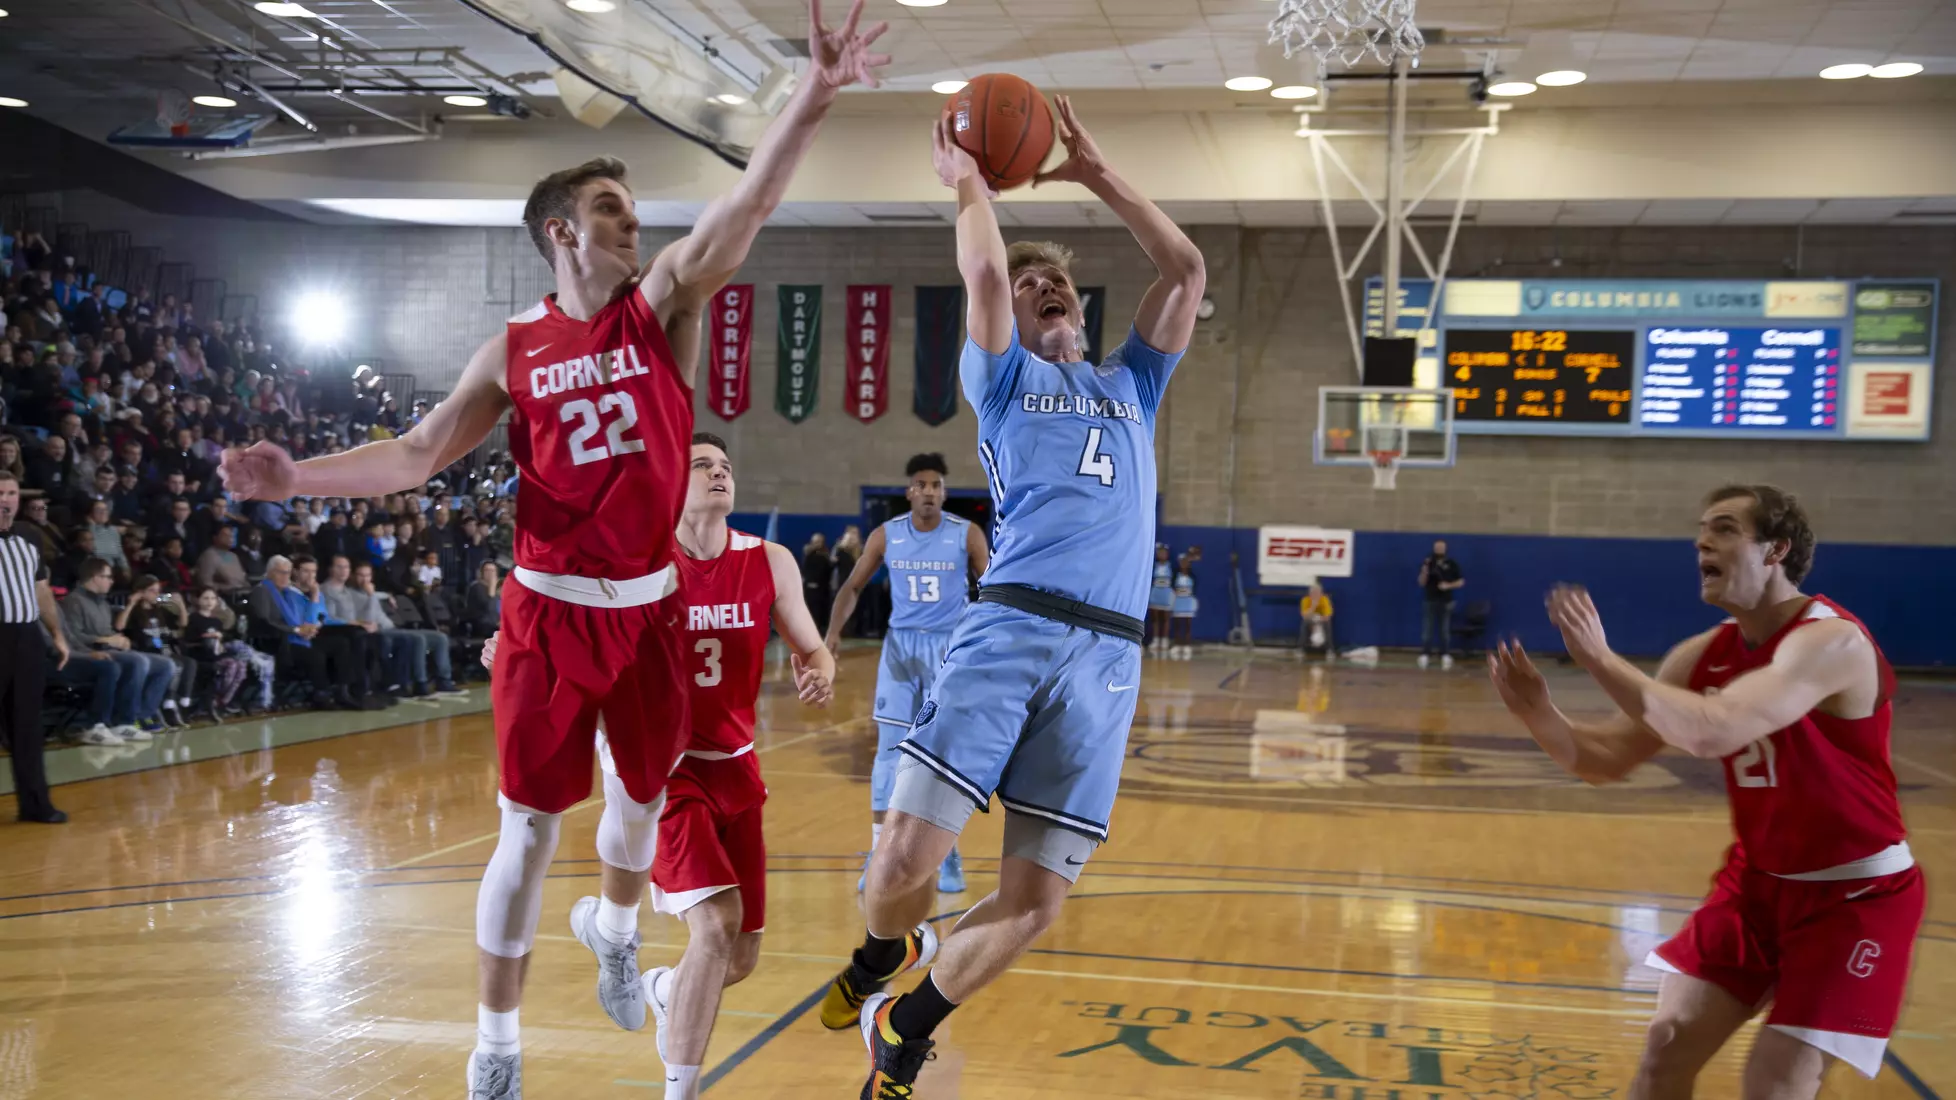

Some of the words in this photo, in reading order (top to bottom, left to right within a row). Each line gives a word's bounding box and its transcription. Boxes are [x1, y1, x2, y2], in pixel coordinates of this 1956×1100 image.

[1551, 289, 1681, 308] COLUMBIA
[1694, 292, 1760, 308] LIONS
[530, 344, 650, 399] CORNELL
[722, 291, 739, 416] CORNELL
[791, 292, 804, 417] DARTMOUTH
[859, 292, 877, 419] HARVARD
[560, 390, 647, 466] 22
[1022, 393, 1142, 425] COLUMBIA
[1075, 426, 1117, 488] 4
[890, 559, 956, 571] COLUMBIA
[1267, 537, 1345, 559] ESPN
[907, 574, 941, 603] 13
[685, 602, 755, 631] RNELL
[694, 637, 723, 688] 3
[1845, 938, 1882, 978] C
[1054, 1022, 1463, 1088] IVY
